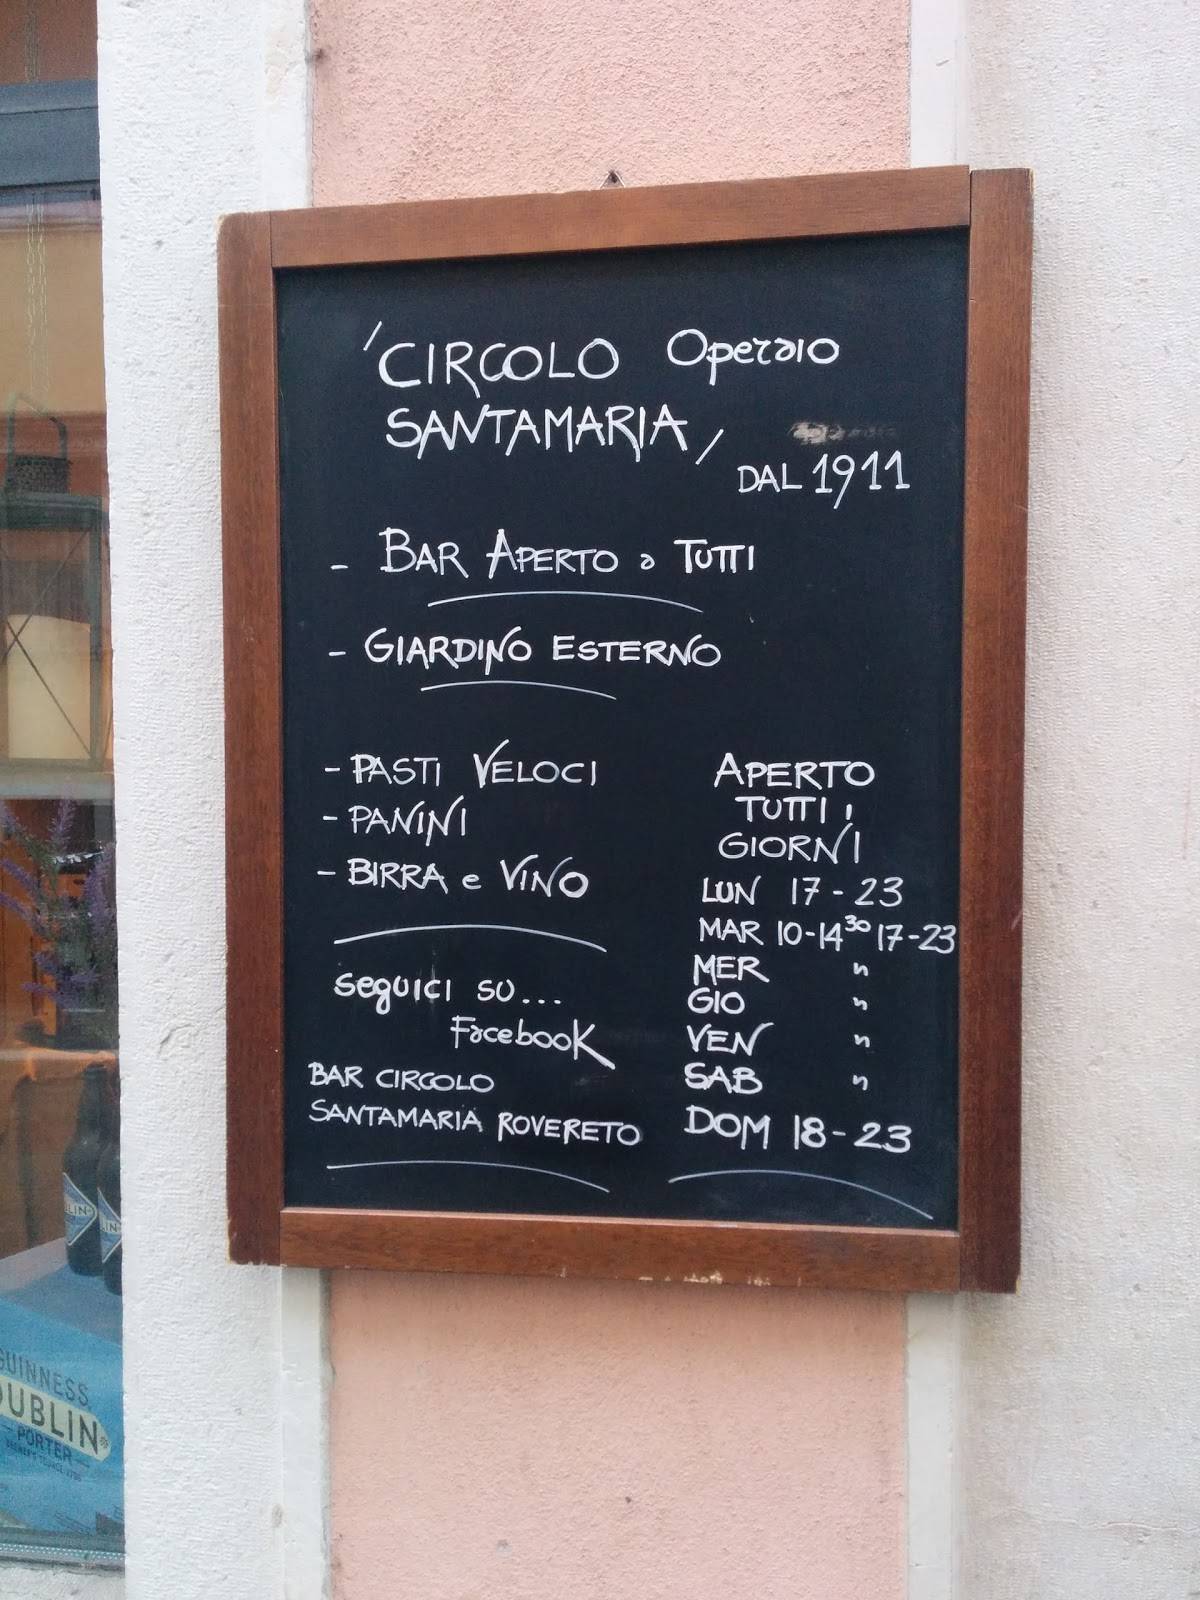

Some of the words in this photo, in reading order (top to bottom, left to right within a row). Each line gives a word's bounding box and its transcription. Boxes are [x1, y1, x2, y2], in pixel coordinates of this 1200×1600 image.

[736, 464, 803, 494] DAL
[811, 449, 911, 510] 1911
[378, 526, 470, 579] BAR
[485, 528, 619, 580] APERTO
[673, 538, 755, 574] TUTTI
[364, 627, 533, 676] GIARDINO
[552, 633, 722, 668] ESTERNO
[349, 753, 441, 787] PASTI
[472, 738, 597, 789] VELOCI
[713, 752, 876, 791] APERTO
[347, 794, 467, 847] PANINI
[734, 795, 828, 825] TUTTI
[718, 822, 861, 865] GIORNI
[346, 857, 449, 895] BIRRA
[461, 873, 482, 890] e
[499, 853, 589, 899] VINO
[701, 875, 762, 906] LUN
[698, 916, 765, 947] MAR
[692, 953, 771, 987] MER
[687, 986, 746, 1015] GIO
[686, 1021, 775, 1057] VEN
[307, 1061, 364, 1089] BAR
[375, 1068, 495, 1093] CIRCOLO
[683, 1061, 763, 1095] SAB
[308, 1098, 484, 1133] SANTAMARIA
[497, 1111, 641, 1146] ROVERETO
[683, 1104, 772, 1151] DOM
